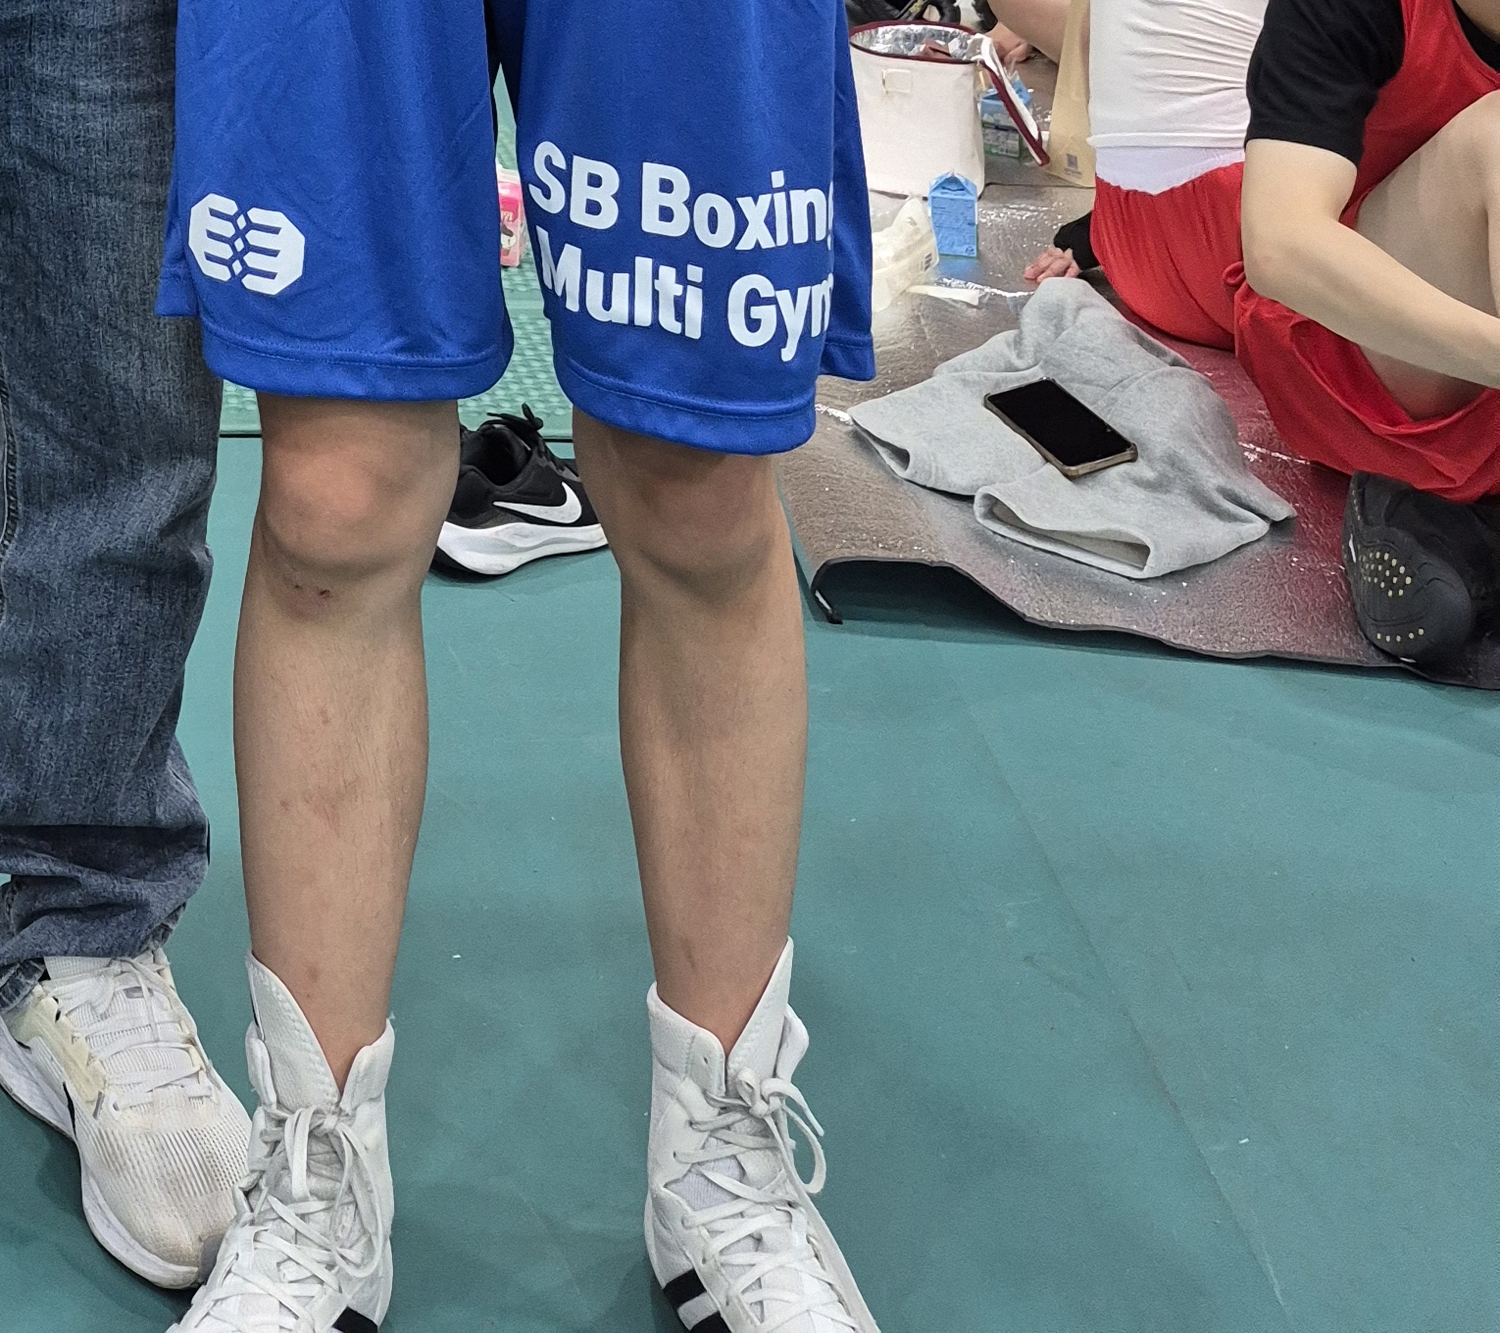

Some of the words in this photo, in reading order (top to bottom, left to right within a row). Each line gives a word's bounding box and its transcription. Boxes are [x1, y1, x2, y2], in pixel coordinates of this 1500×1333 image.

[529, 140, 620, 230] SB
[640, 162, 834, 251] Boxin
[538, 226, 703, 340] Multi
